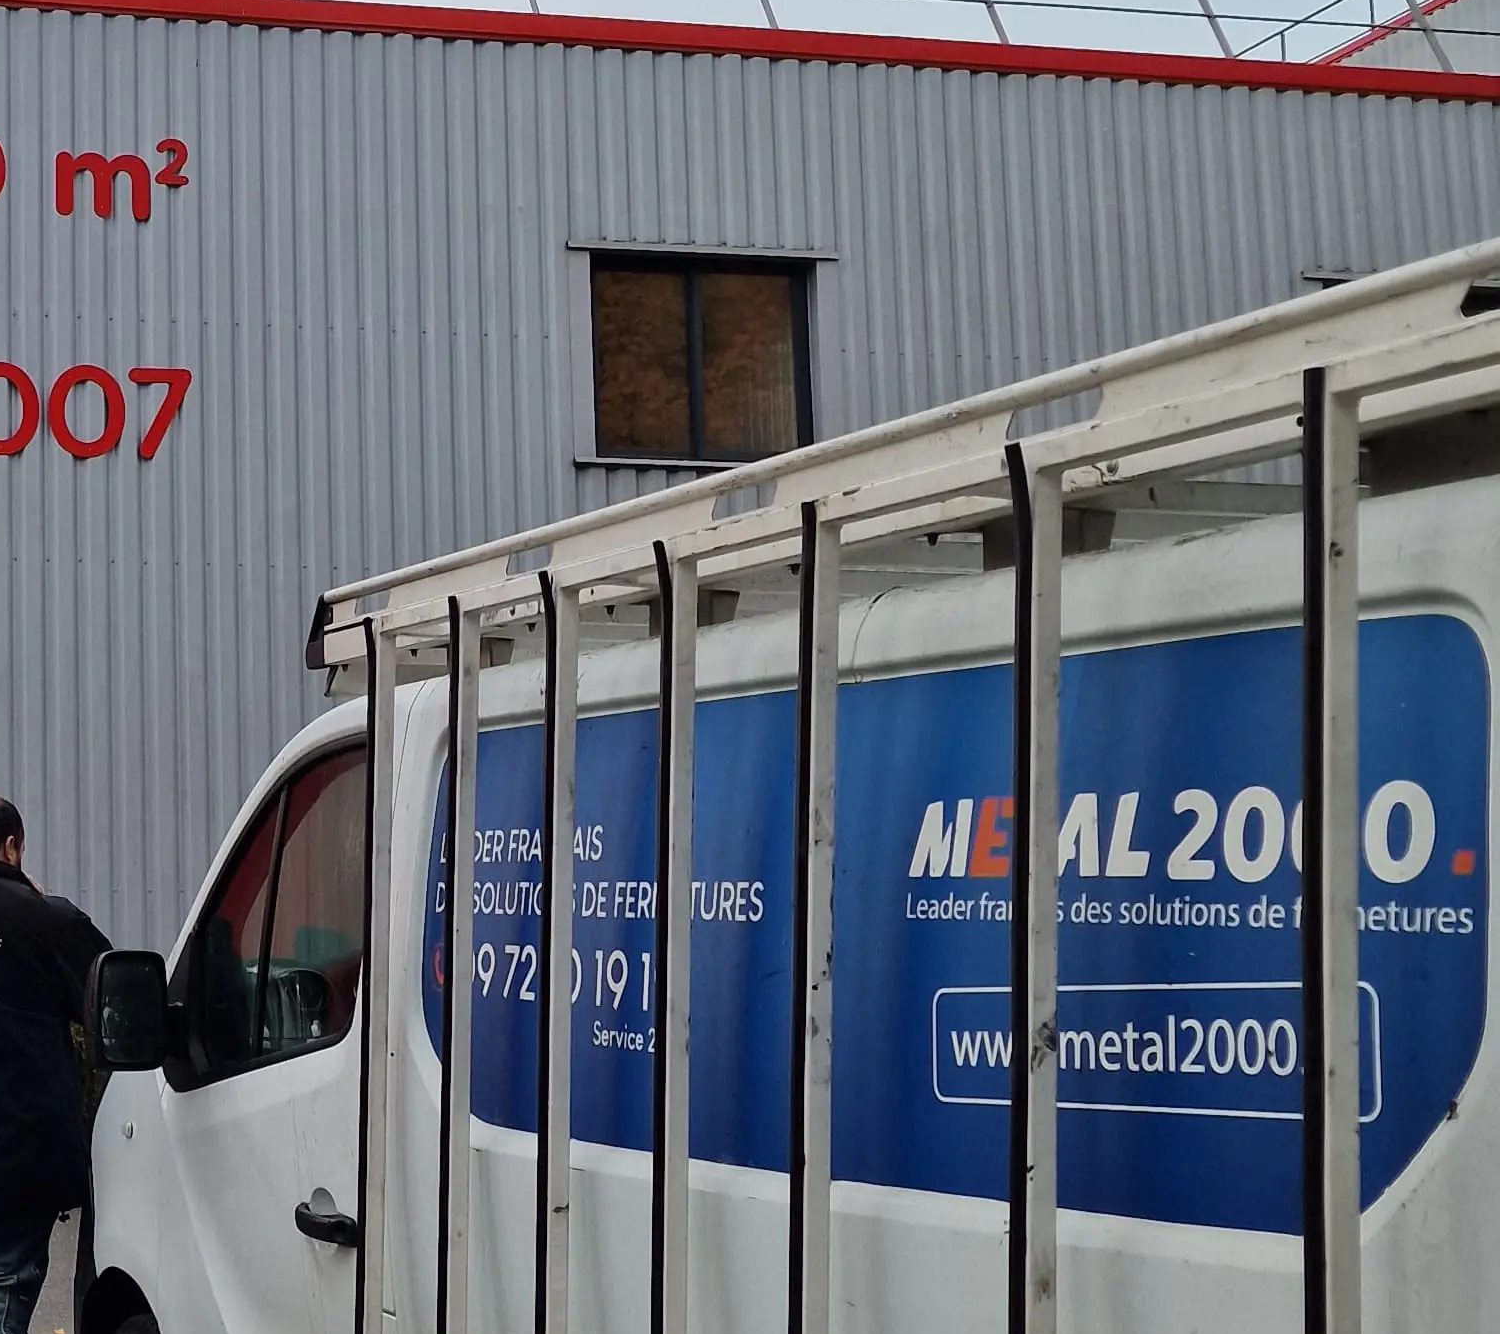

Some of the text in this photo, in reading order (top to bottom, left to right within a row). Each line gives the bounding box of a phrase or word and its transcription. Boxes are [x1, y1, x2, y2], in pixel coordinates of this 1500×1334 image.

[54, 137, 189, 221] m²
[439, 824, 604, 864] LDER FRAAIS
[908, 779, 1476, 884] MEAL 200.
[581, 881, 609, 918] DE
[613, 881, 765, 923] FERTURES
[906, 891, 975, 921] Leader
[980, 892, 1064, 922] fras
[1070, 893, 1113, 924] des
[1118, 893, 1240, 928] solutions
[1248, 894, 1286, 929] de
[472, 942, 496, 998] 9
[502, 944, 537, 1002] 72
[595, 949, 628, 1011] 19
[592, 1020, 644, 1051] Service
